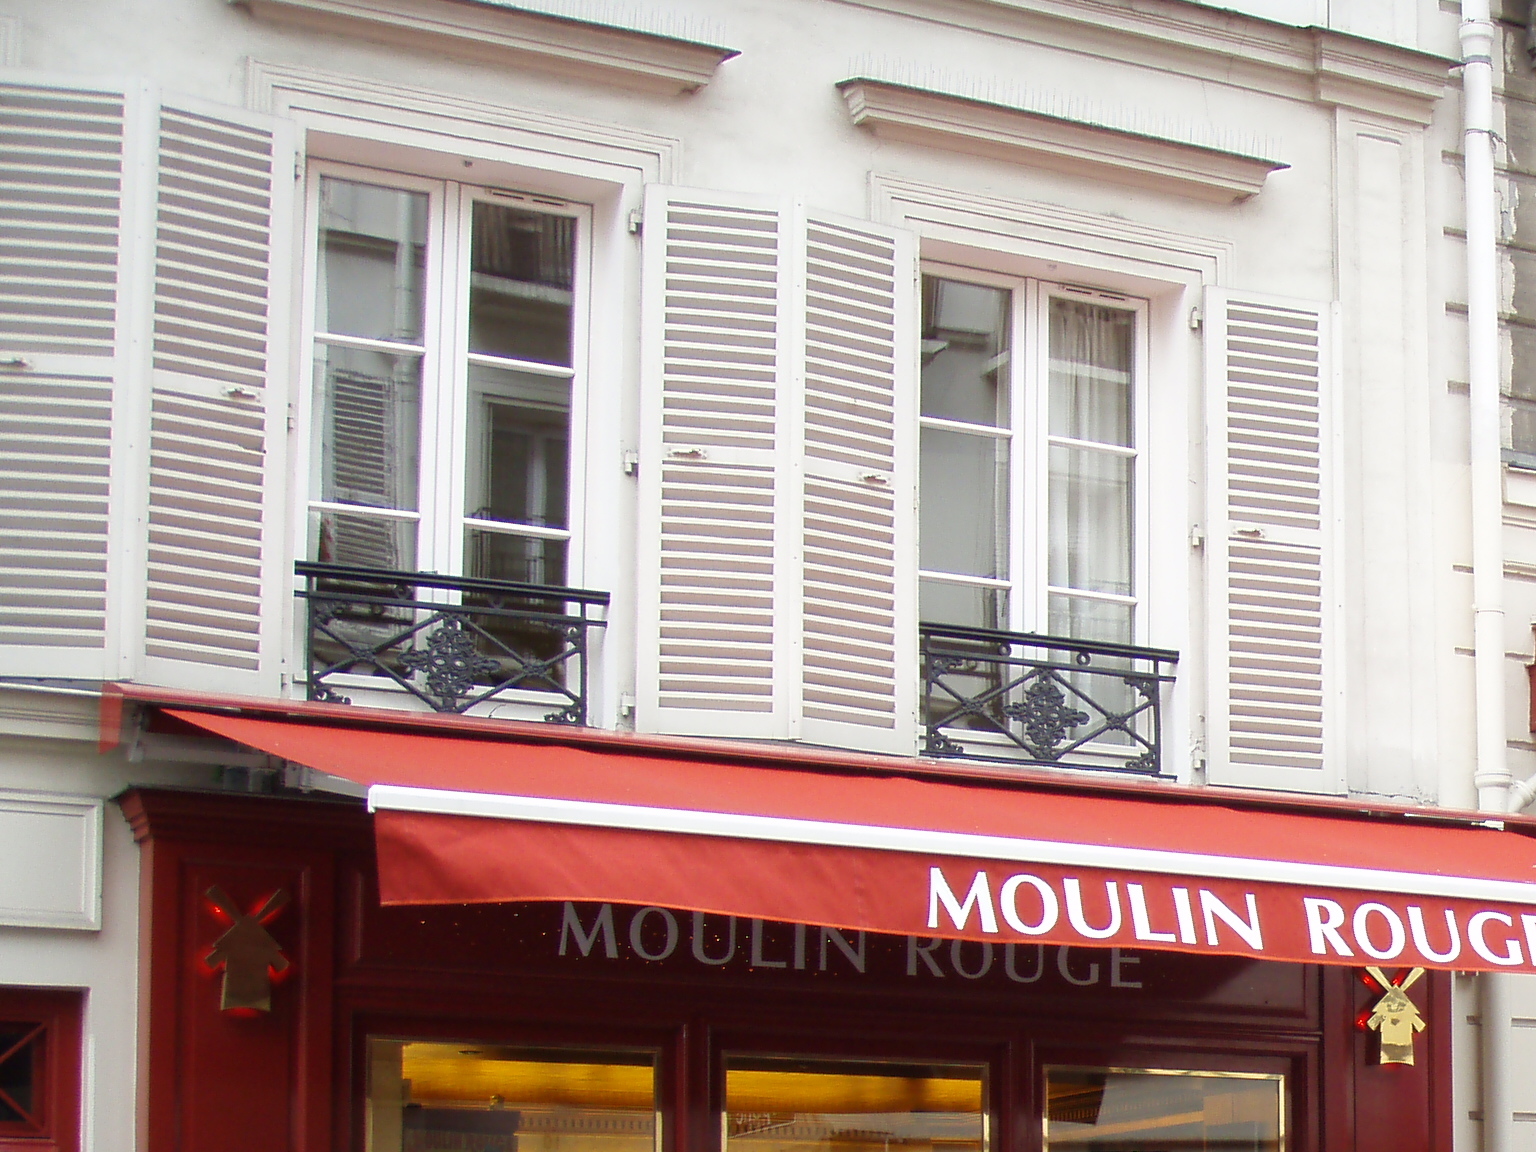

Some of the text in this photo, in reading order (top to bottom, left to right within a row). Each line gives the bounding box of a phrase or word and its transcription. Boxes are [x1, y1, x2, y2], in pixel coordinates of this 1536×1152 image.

[558, 901, 1143, 990] MOULIN ROUGE
[926, 866, 1265, 951] MOULIN
